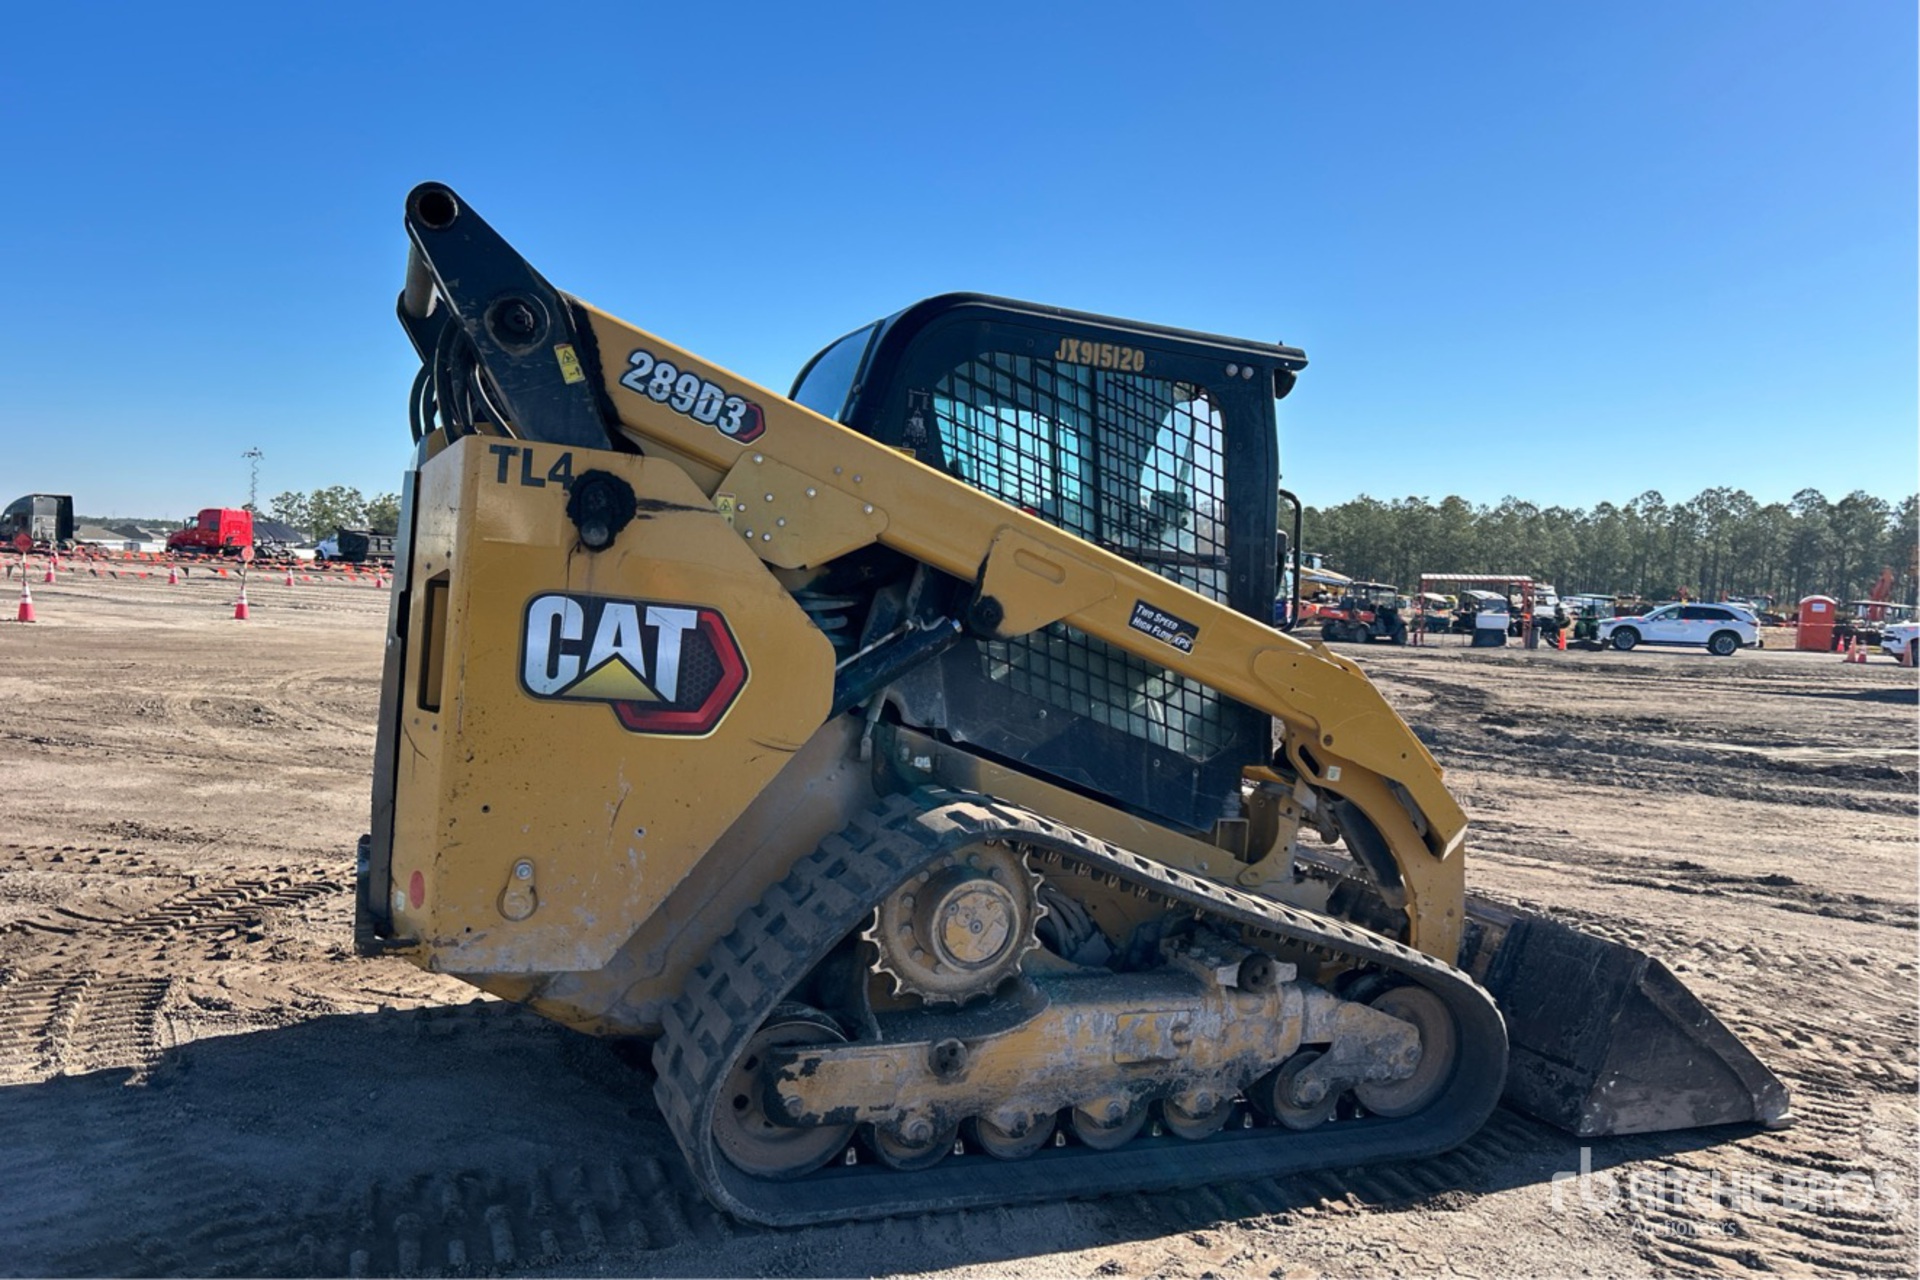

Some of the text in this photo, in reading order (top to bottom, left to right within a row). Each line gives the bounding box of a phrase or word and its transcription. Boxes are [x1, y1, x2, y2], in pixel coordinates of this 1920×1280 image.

[1055, 338, 1145, 372] JX915120
[621, 351, 747, 435] 289D3
[489, 444, 575, 490] TL4
[525, 595, 698, 703] CAT
